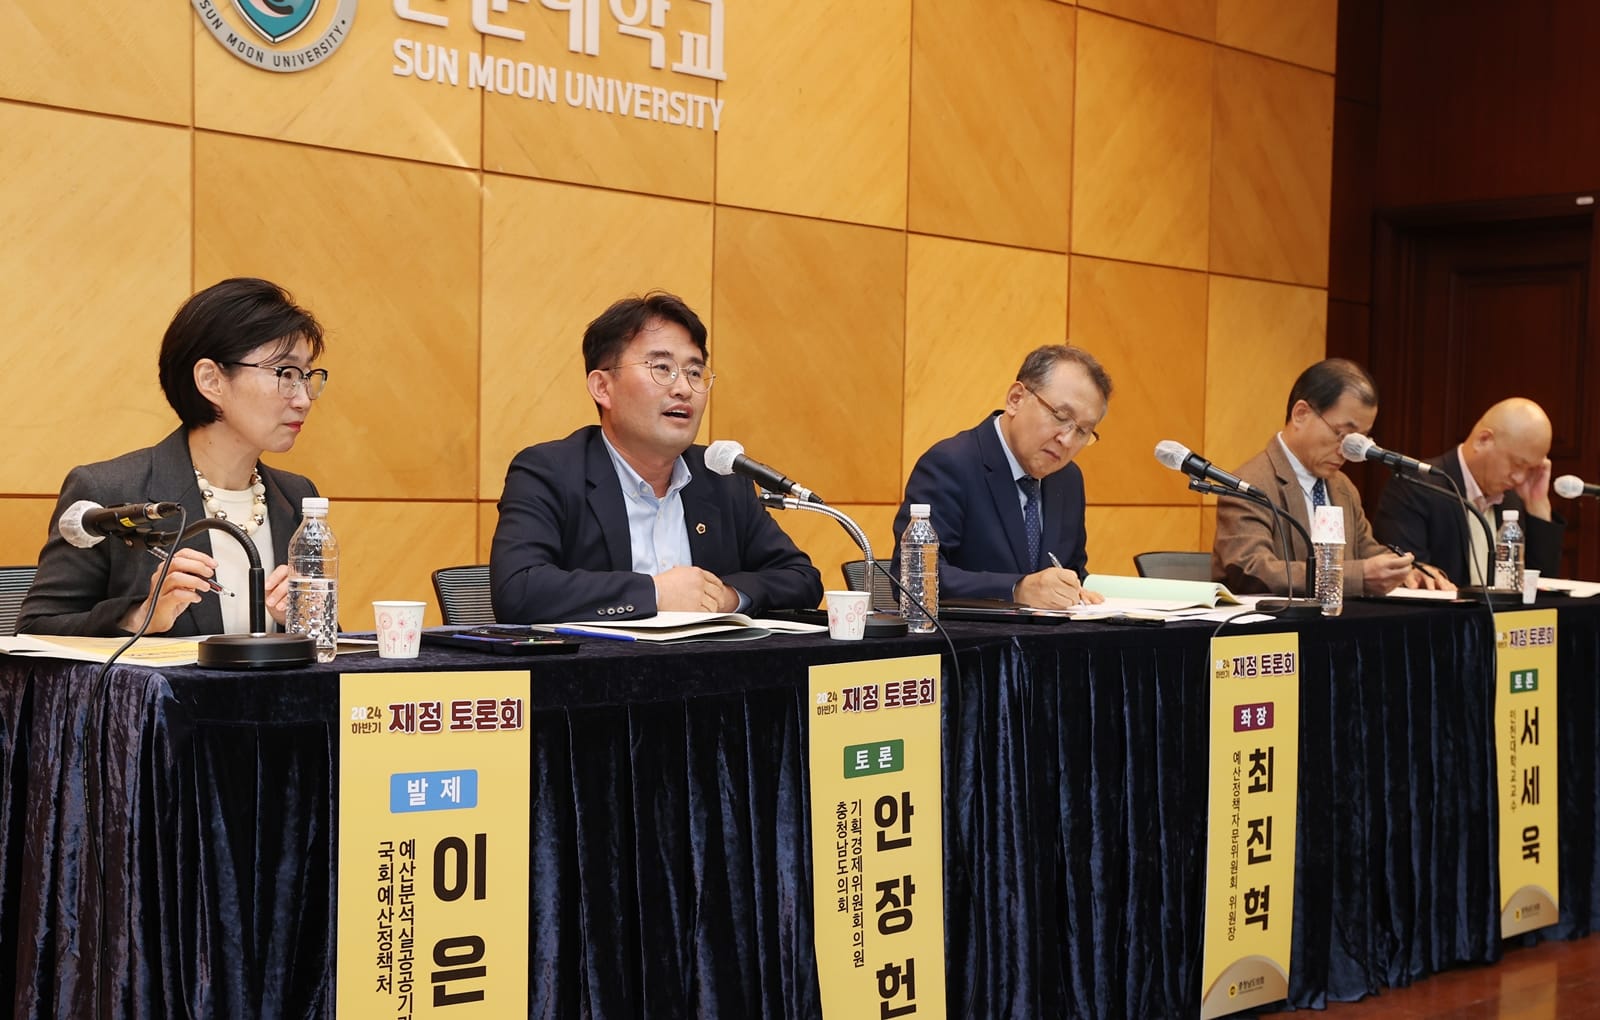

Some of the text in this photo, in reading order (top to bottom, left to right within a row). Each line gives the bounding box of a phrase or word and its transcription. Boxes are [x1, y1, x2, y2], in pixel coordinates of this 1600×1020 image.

[200, 0, 344, 68] SUN MOON UNIVERSITY
[392, 38, 725, 132] SUN MOON UNIVERSITY
[816, 691, 838, 704] 2024
[842, 677, 935, 711] 재정 토론회
[1232, 652, 1295, 677] 재정 토론회
[351, 706, 382, 720] 2024
[351, 722, 382, 735] 하반기
[388, 698, 522, 733] 재정 토론회
[817, 704, 838, 716] 하반기
[407, 775, 461, 807] 발제
[855, 745, 893, 771] 토론
[1521, 706, 1540, 864] 서세욱
[836, 801, 848, 914] 충청남도의회
[1244, 746, 1274, 931] 최진혁
[850, 799, 864, 968] 기획경제위원회의원
[874, 791, 917, 1020] 안장헌
[376, 841, 395, 995] 국회예산정책처
[397, 838, 416, 1020] 예산분석실공공기
[431, 833, 487, 1008] 이은
